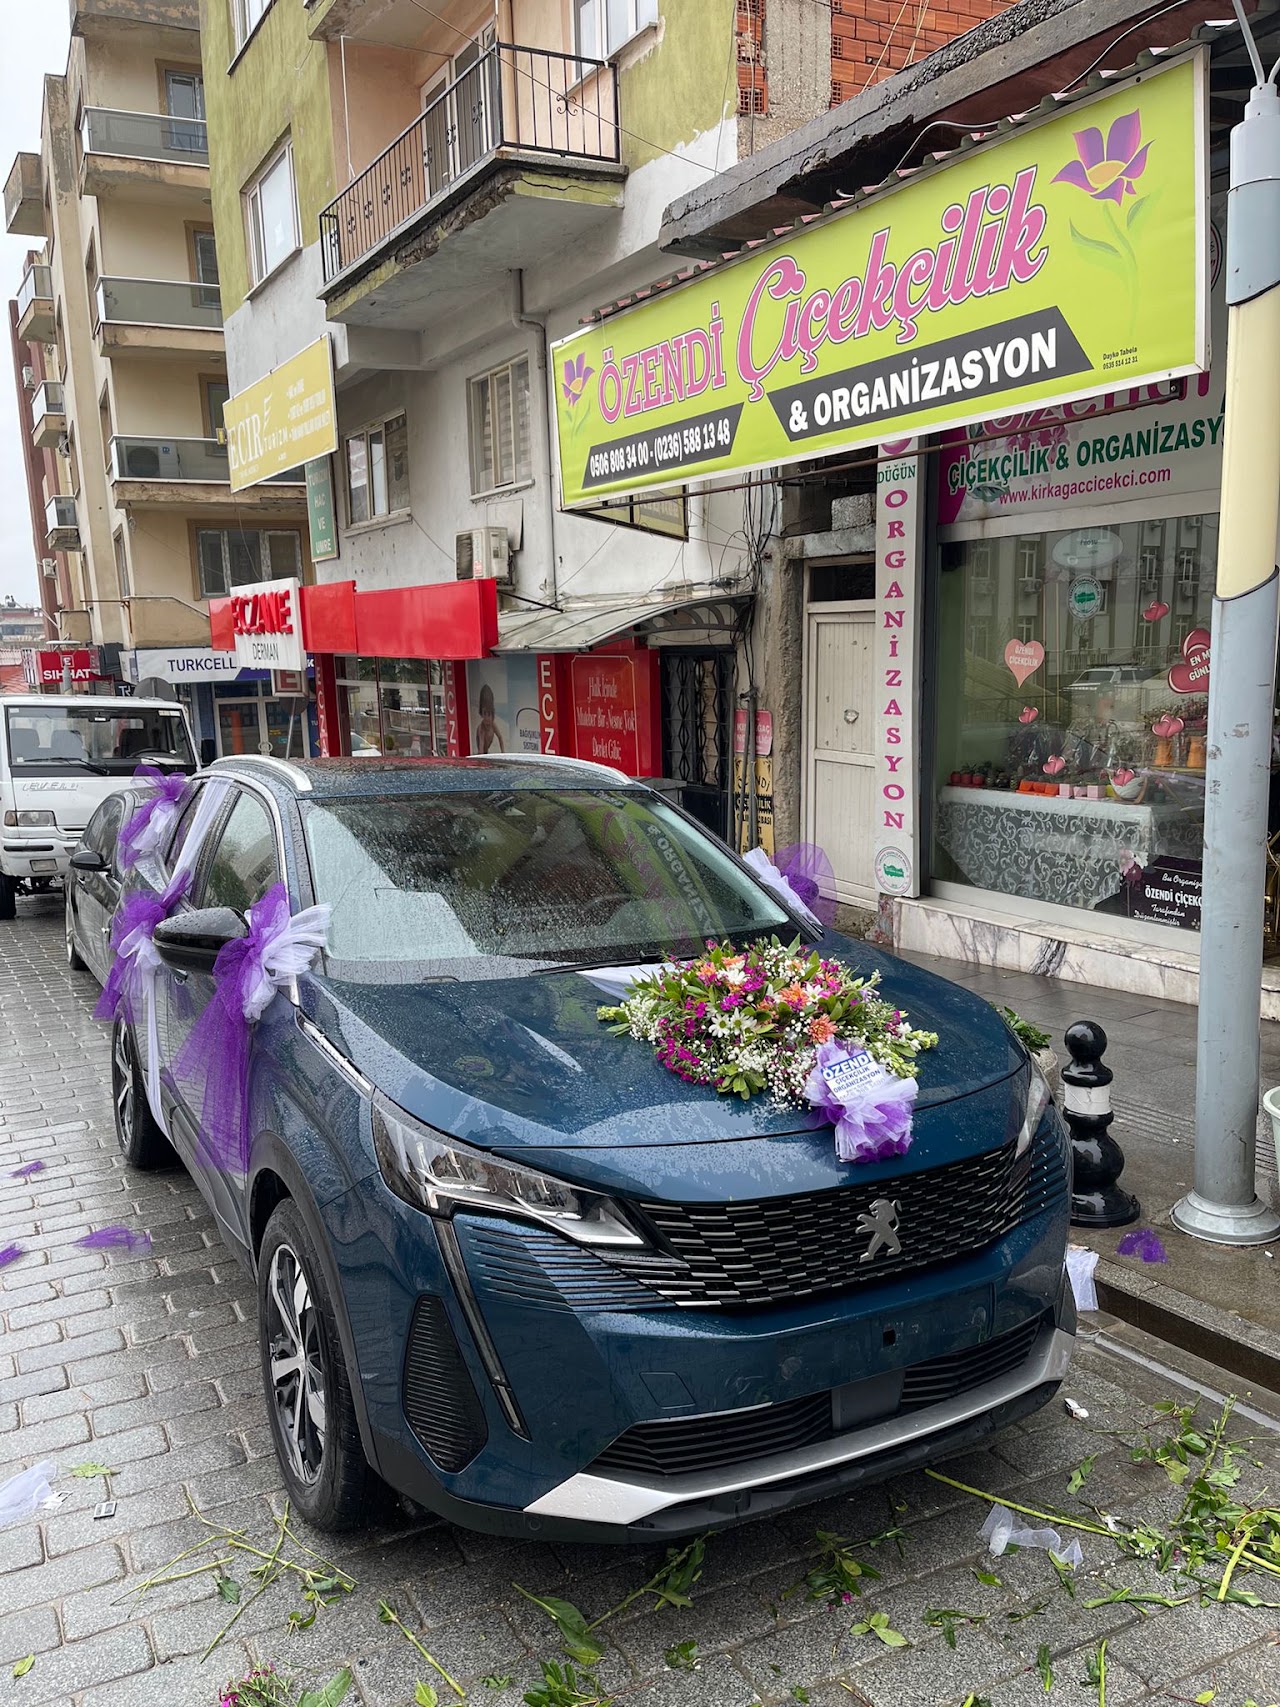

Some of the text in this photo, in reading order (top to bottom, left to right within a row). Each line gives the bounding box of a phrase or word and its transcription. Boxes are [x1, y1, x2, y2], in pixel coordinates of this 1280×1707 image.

[599, 164, 1049, 424] ÖZENDİ Çiçekçilik
[788, 392, 809, 433] &
[813, 327, 1057, 427] ORGANİZASYON
[589, 452, 610, 478] 0506
[610, 447, 626, 473] 808
[626, 443, 637, 469] 34
[637, 441, 649, 466] 00
[654, 431, 683, 467] (0236)
[683, 426, 702, 455] 588
[702, 422, 716, 450] 13
[716, 418, 731, 445] 48
[948, 415, 1225, 493] ÇİÇEKÇİLİK & ORGANİZASY
[876, 462, 917, 484] DÜĞÜN
[999, 467, 1171, 505] www.kirkagaccicekci.com
[231, 589, 293, 636] ECZANE
[167, 656, 237, 672] TURKCELL
[252, 642, 280, 661] DERMAN
[882, 488, 908, 829] ORGANİZASYON
[1189, 654, 1202, 667] EN
[1145, 885, 1174, 903] ÖZENDİ
